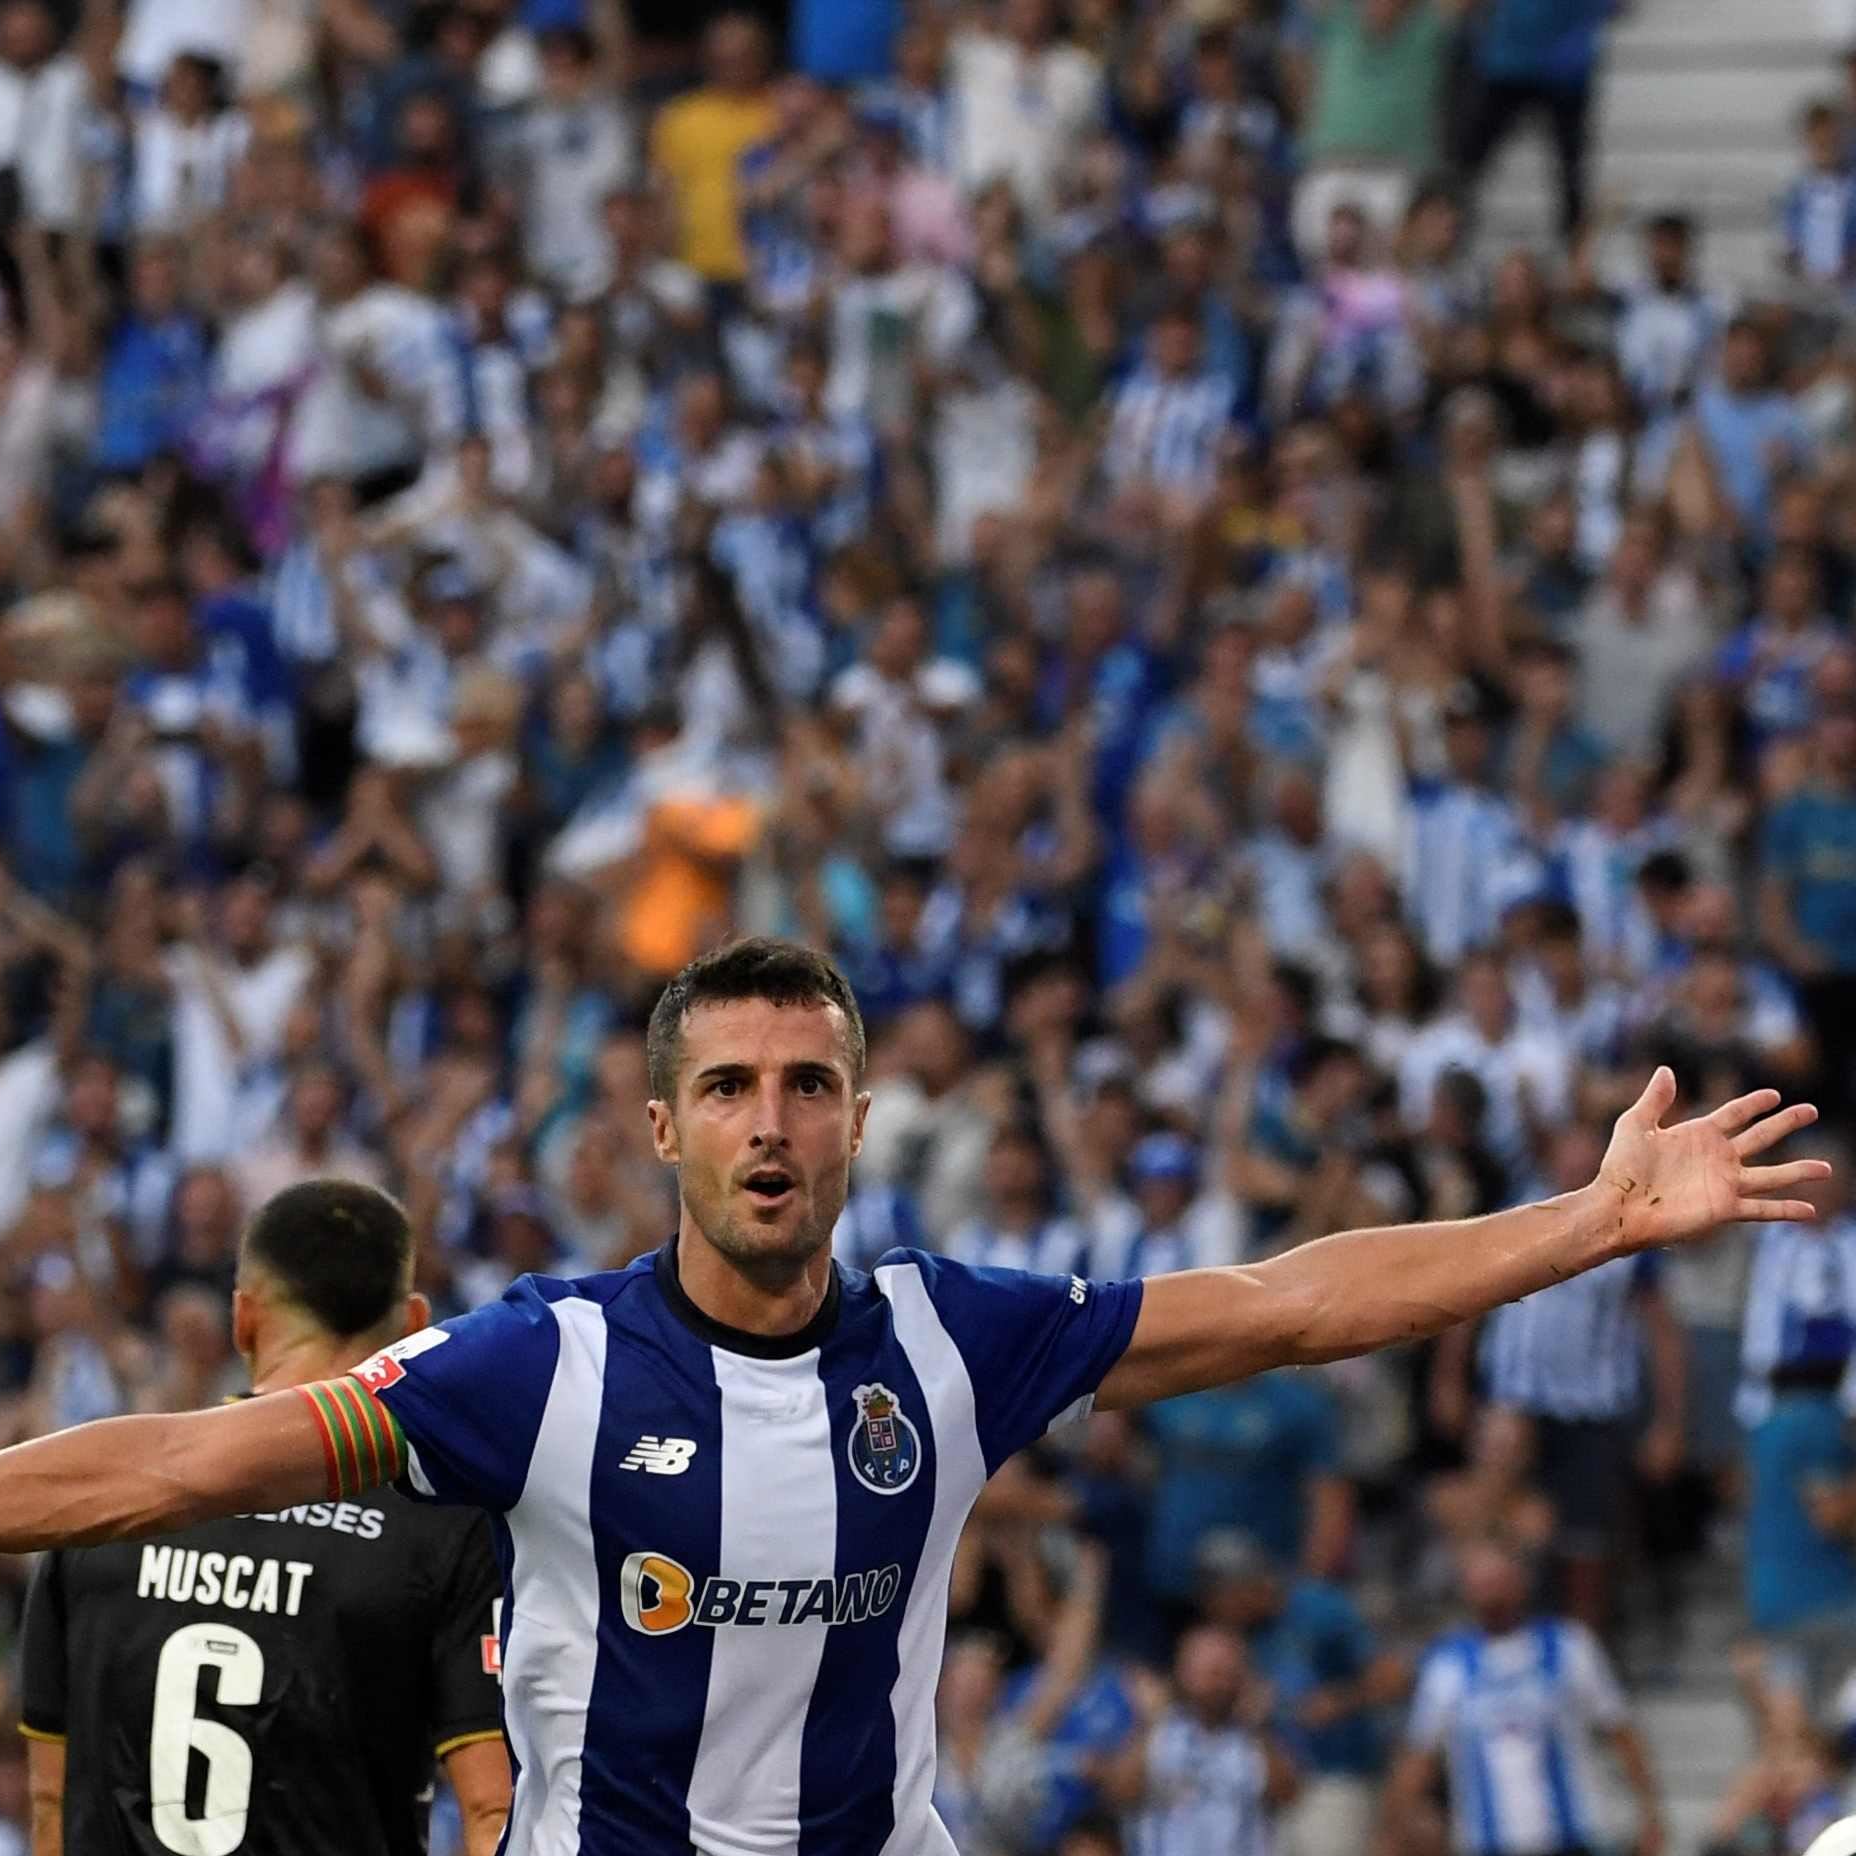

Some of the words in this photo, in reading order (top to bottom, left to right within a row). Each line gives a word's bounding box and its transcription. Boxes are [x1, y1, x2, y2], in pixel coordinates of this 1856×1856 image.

[234, 1500, 386, 1540] NSES
[136, 1544, 313, 1616] MUSCAT
[695, 1563, 902, 1626] BETANO
